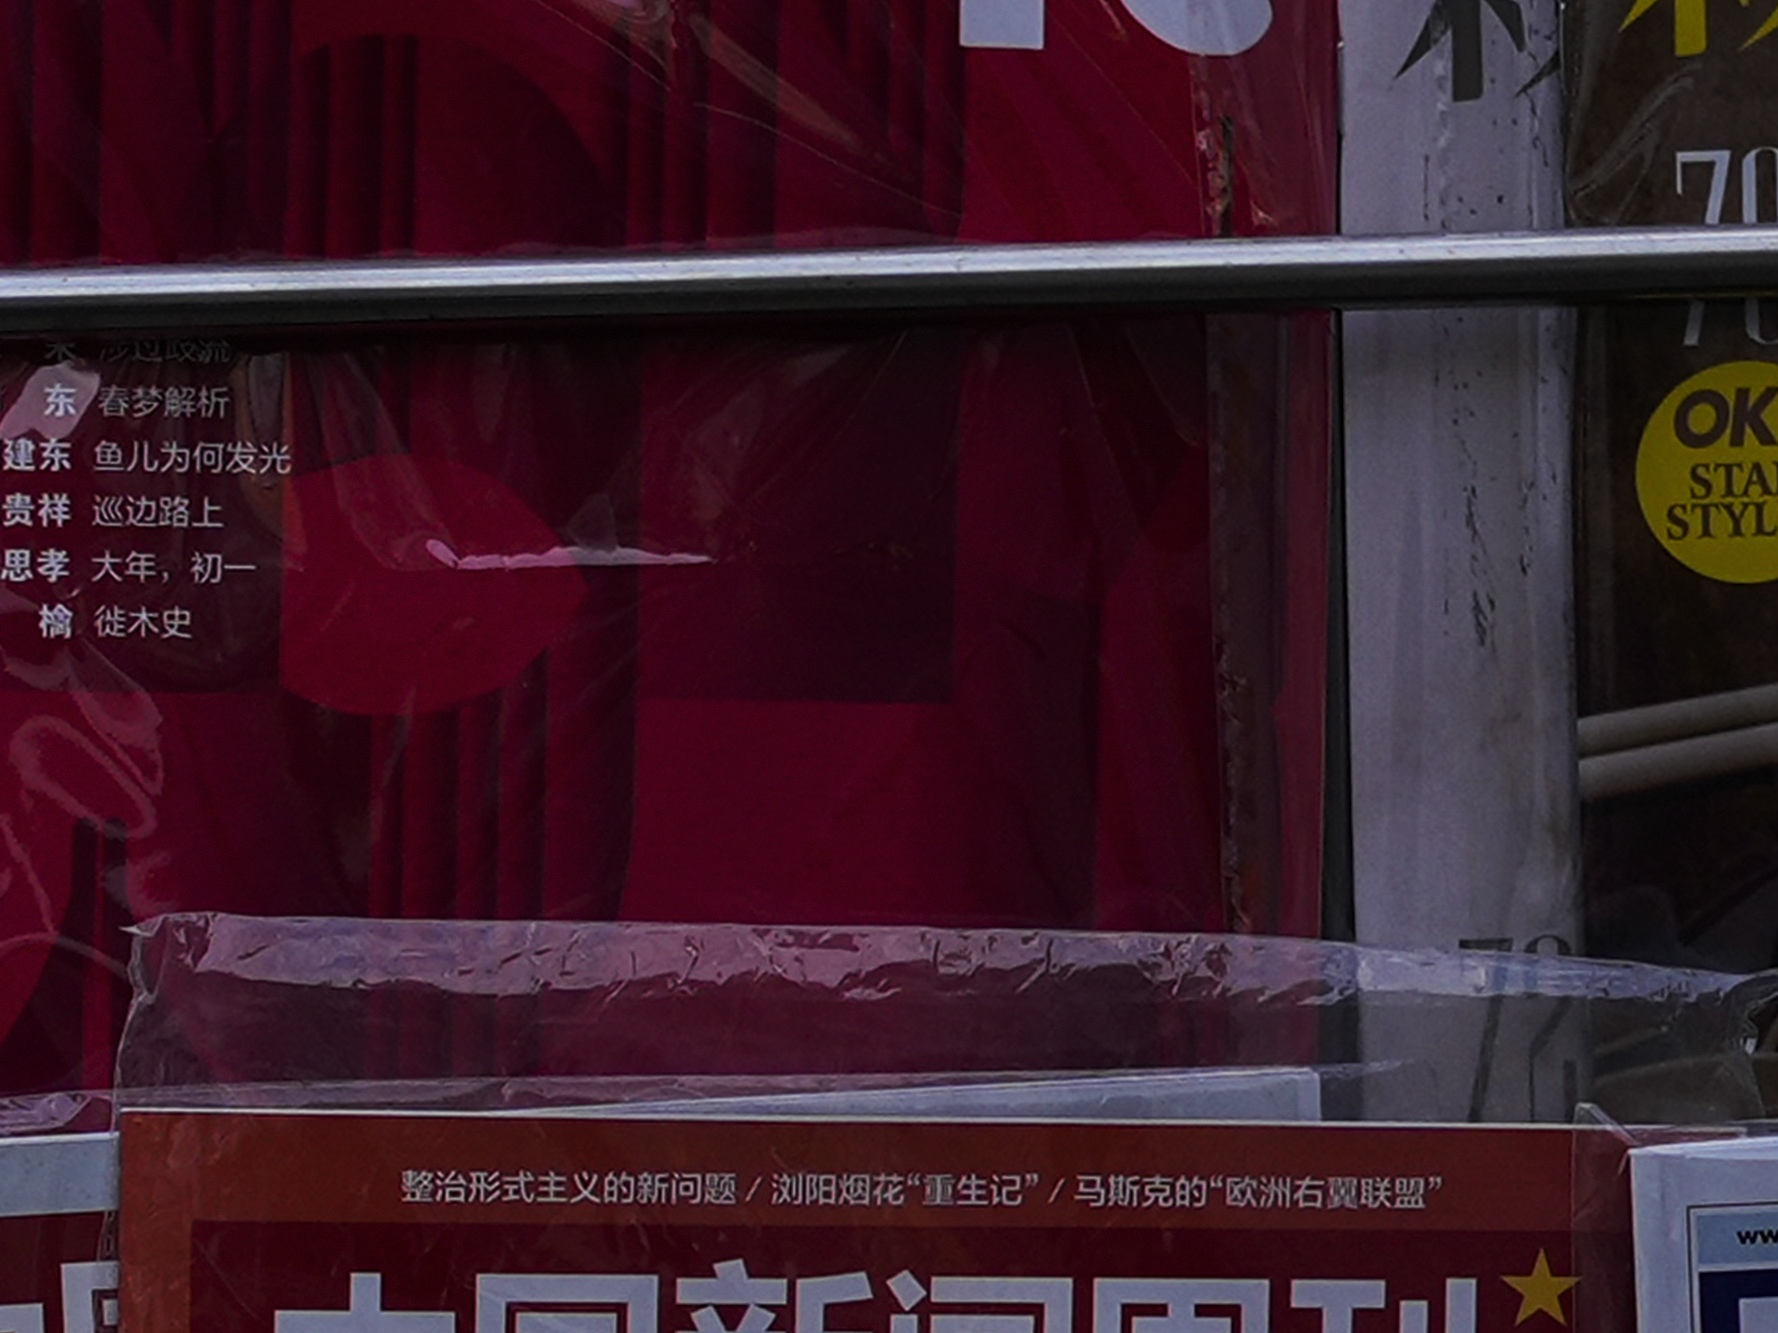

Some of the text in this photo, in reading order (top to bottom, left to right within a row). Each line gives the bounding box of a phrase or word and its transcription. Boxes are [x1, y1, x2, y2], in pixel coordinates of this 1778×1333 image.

[98, 385, 232, 418] 春梦解析
[93, 441, 293, 475] 鱼儿为何发光
[1690, 461, 1778, 499] STA
[92, 494, 225, 528] 巡边路上
[401, 1170, 738, 1205] 整治形式主义的新问题
